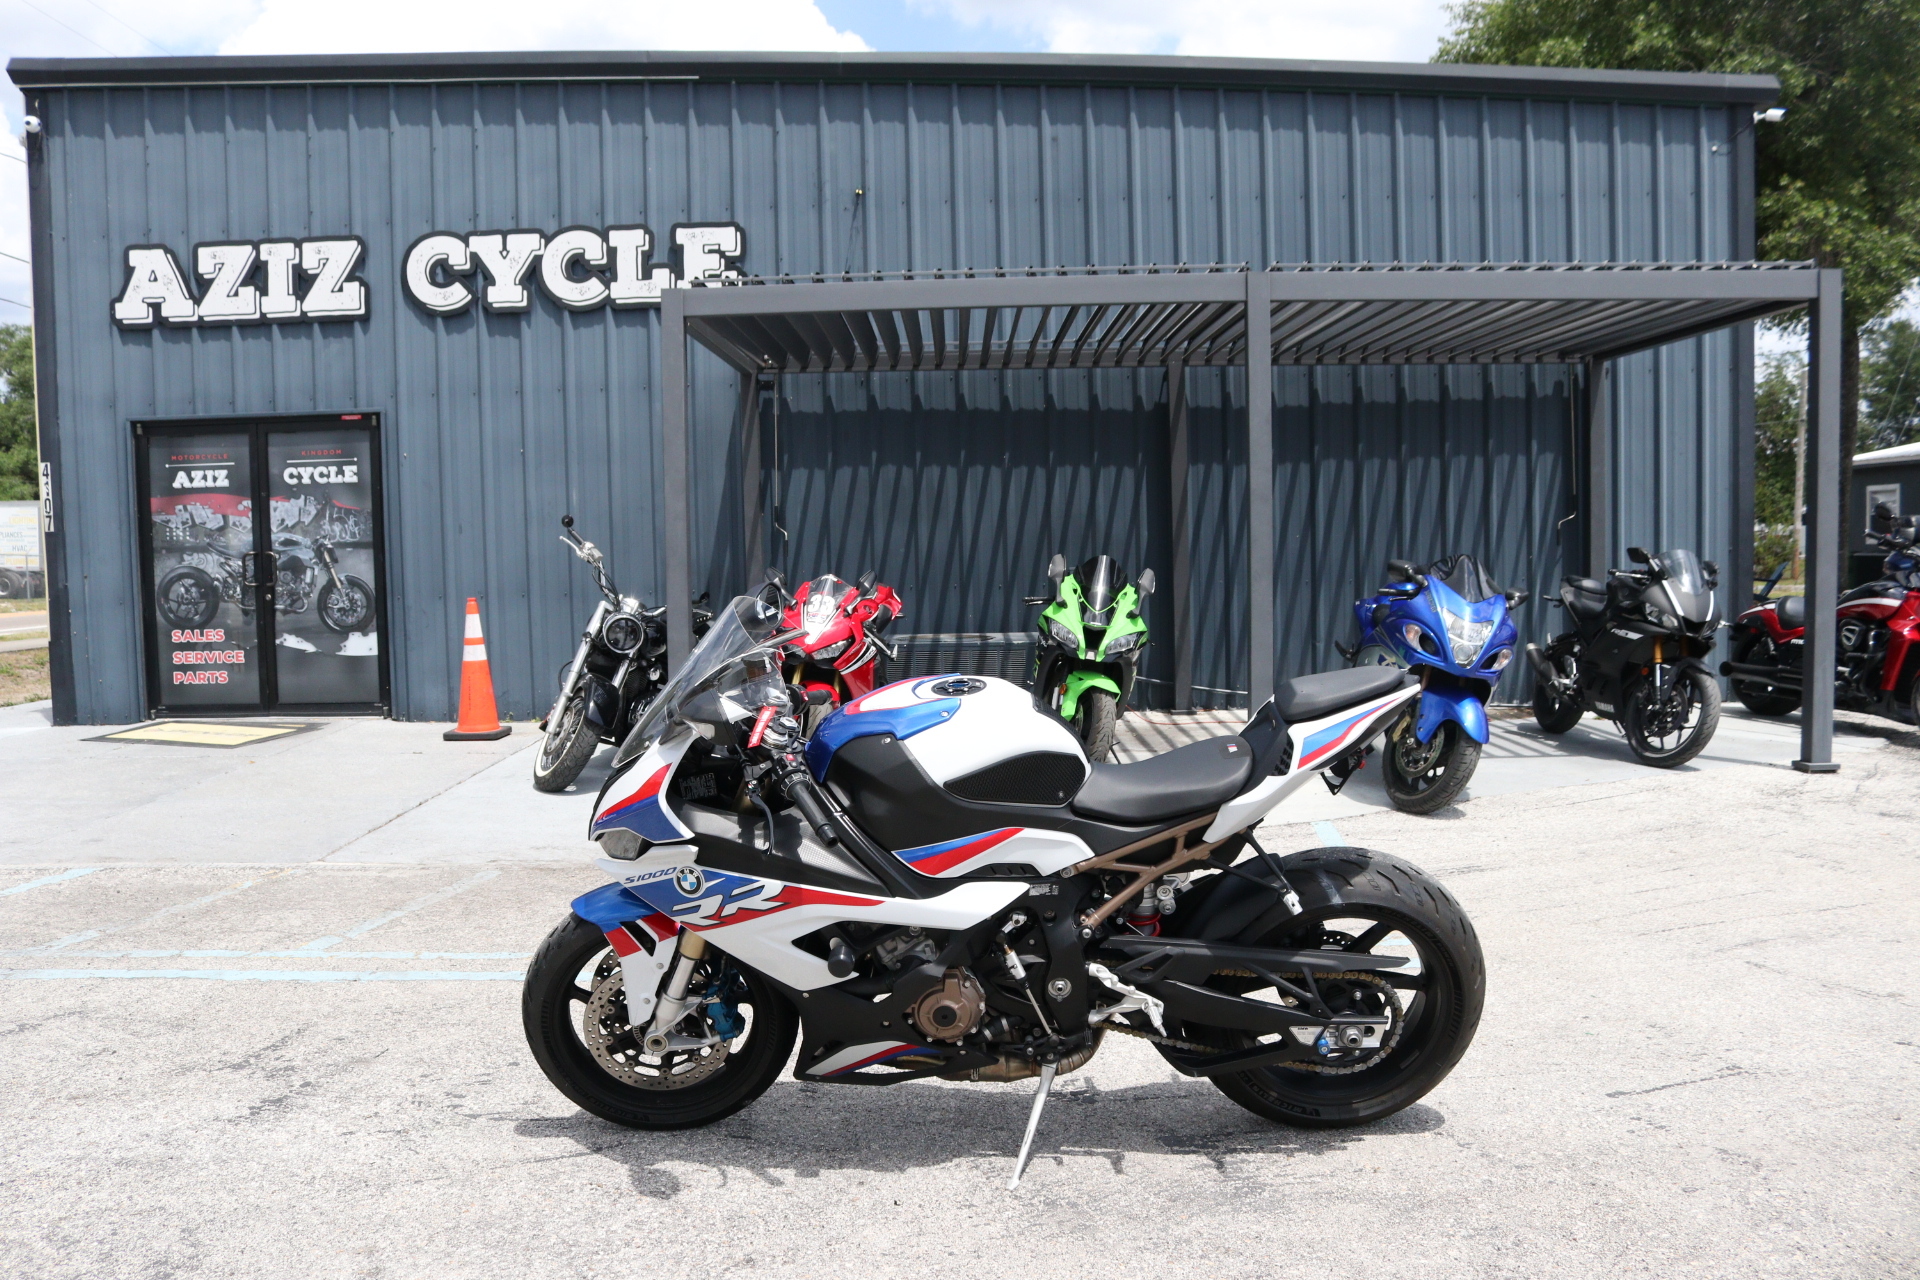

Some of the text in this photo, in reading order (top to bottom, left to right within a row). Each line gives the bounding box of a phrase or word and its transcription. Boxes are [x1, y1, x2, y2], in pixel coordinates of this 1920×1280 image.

[113, 227, 743, 325] AZIZ CYCLE
[171, 453, 229, 461] MOTORCYCLE
[172, 469, 230, 489] AZIZ
[283, 465, 358, 485] CYCLE
[807, 594, 836, 615] 33
[171, 628, 225, 643] SALES
[172, 650, 245, 664] SERVICE
[173, 671, 228, 684] PARTS
[624, 866, 678, 885] S1000
